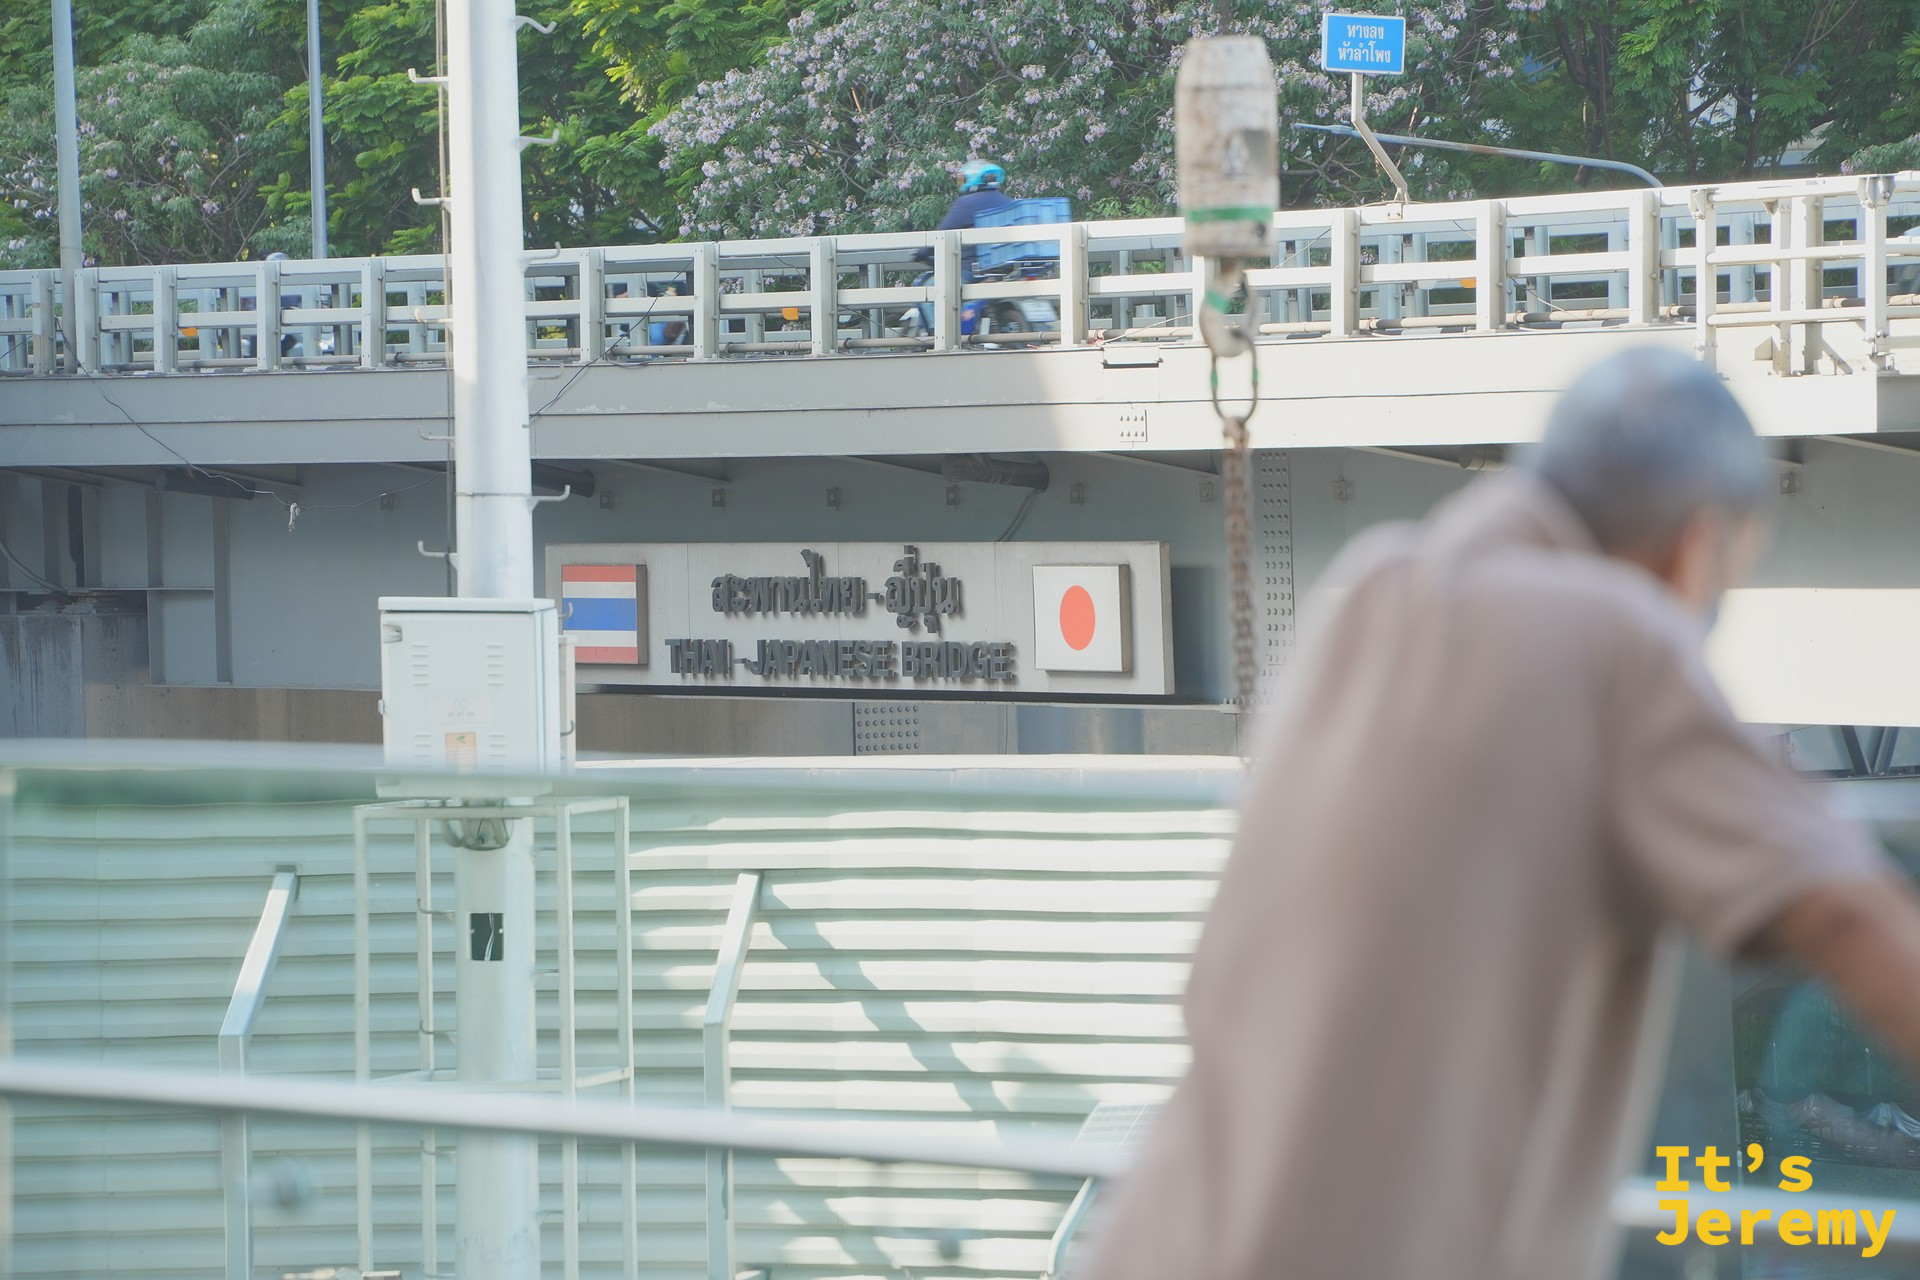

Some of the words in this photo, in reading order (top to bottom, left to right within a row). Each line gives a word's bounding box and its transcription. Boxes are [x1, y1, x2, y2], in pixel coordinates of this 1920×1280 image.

[1346, 24, 1385, 40] ทางลง
[1337, 40, 1391, 63] หัวลำโพง
[902, 641, 1017, 680] BRIDGE
